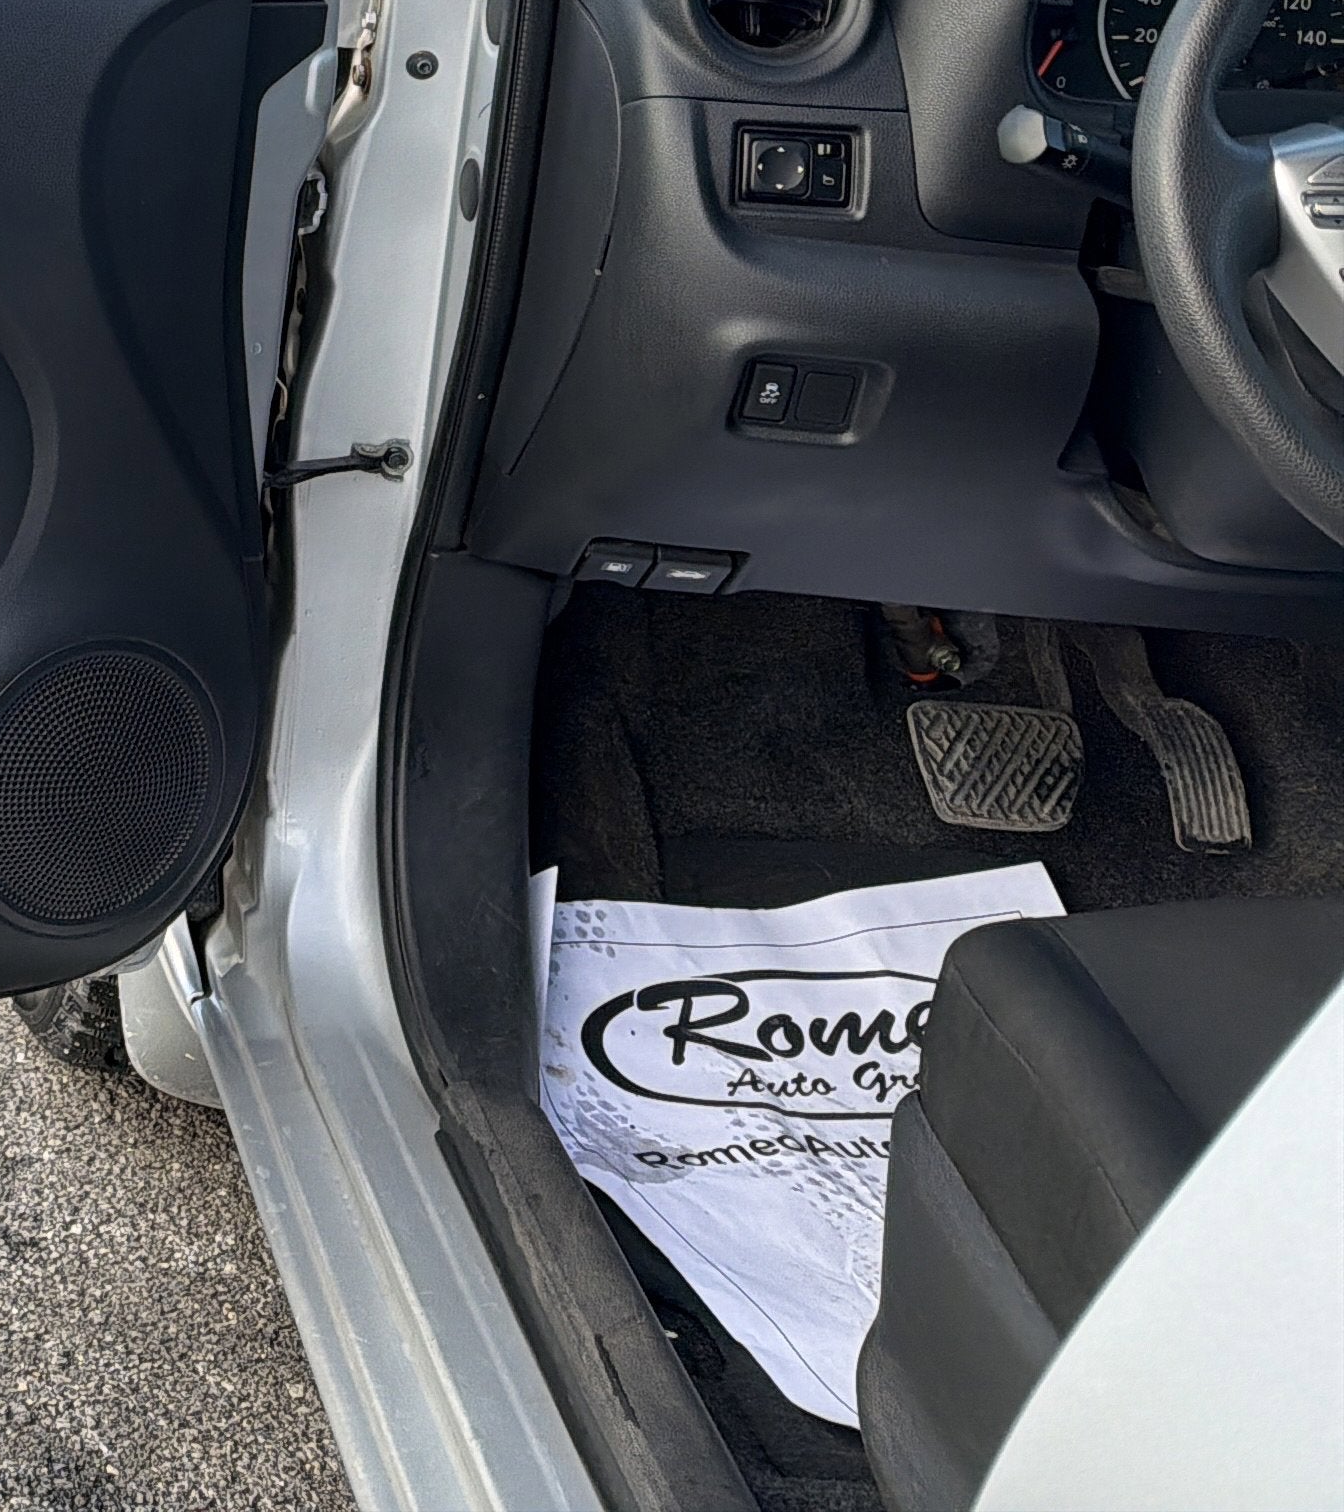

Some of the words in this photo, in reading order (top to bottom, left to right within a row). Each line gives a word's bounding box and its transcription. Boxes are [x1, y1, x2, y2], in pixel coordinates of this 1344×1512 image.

[1134, 28, 1158, 44] 20
[1296, 30, 1327, 46] 140
[1055, 76, 1067, 89] 0
[727, 1067, 836, 1097] Auto
